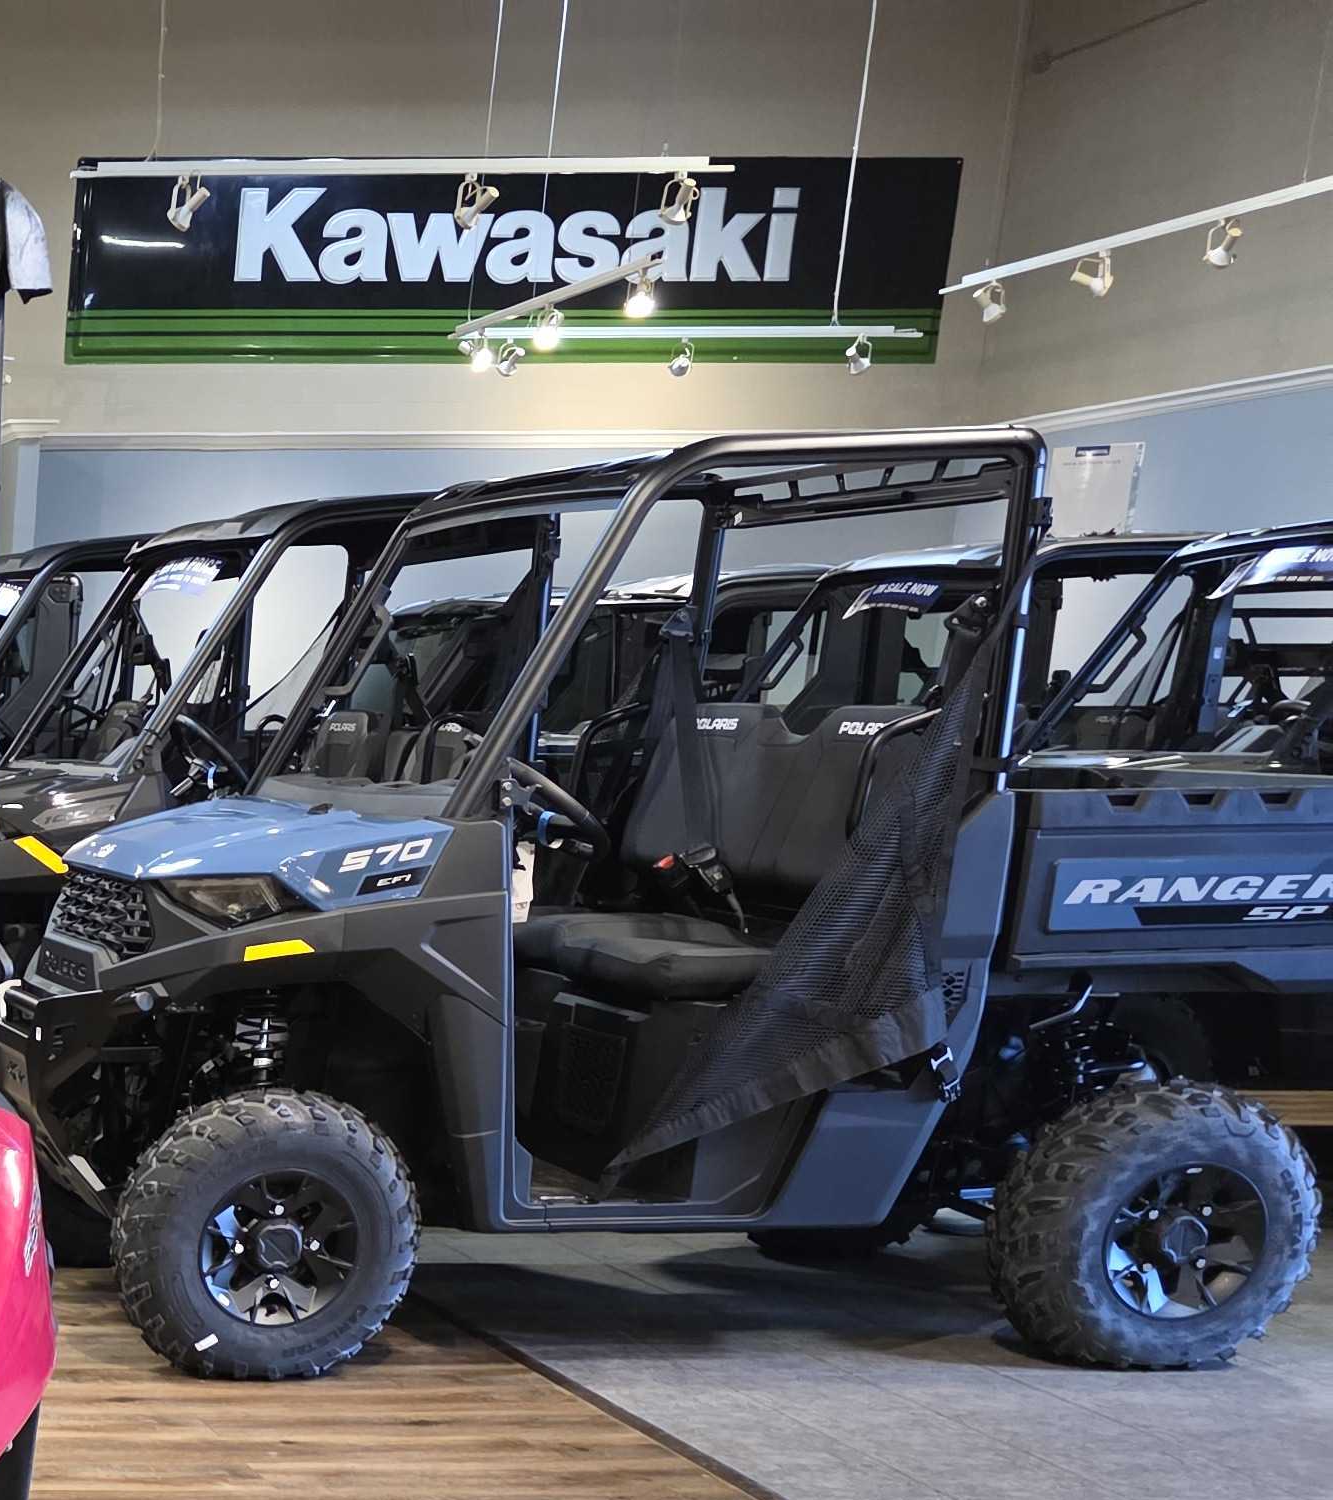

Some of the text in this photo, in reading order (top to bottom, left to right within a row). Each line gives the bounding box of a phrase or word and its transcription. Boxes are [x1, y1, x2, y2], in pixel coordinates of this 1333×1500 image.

[234, 185, 801, 285] Kawasaki
[908, 583, 939, 597] NOW
[338, 838, 433, 873] 570
[376, 873, 412, 887] EFI
[1242, 905, 1329, 921] SP
